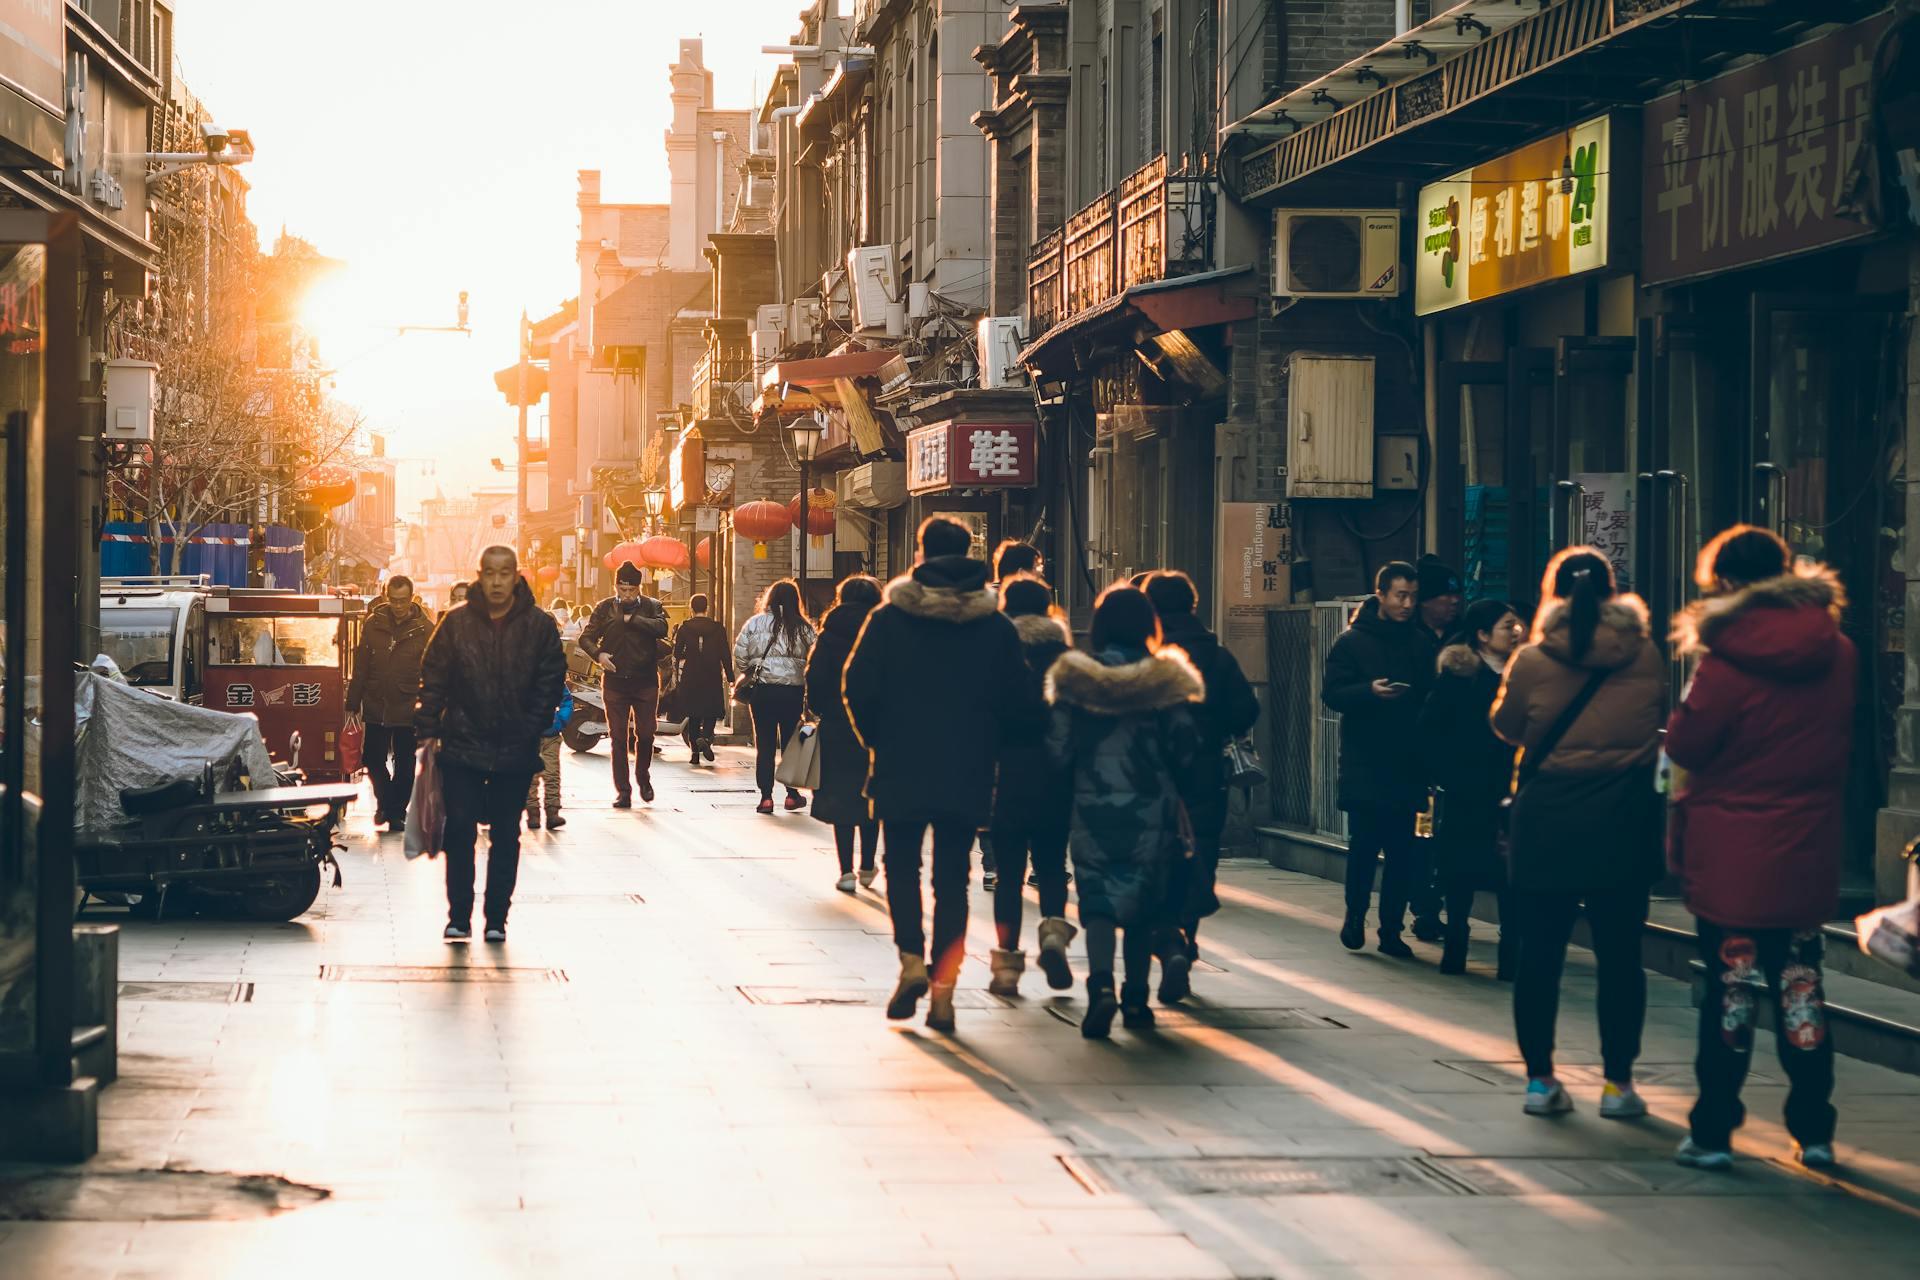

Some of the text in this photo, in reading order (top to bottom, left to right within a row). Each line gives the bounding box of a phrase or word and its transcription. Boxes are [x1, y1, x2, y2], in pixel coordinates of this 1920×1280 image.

[1658, 44, 1873, 261] 平价服装店
[969, 430, 1020, 477] 鞋
[1243, 547, 1254, 598] Restaurant
[1263, 560, 1277, 592] 饭庄
[226, 683, 321, 706] 金 彭
